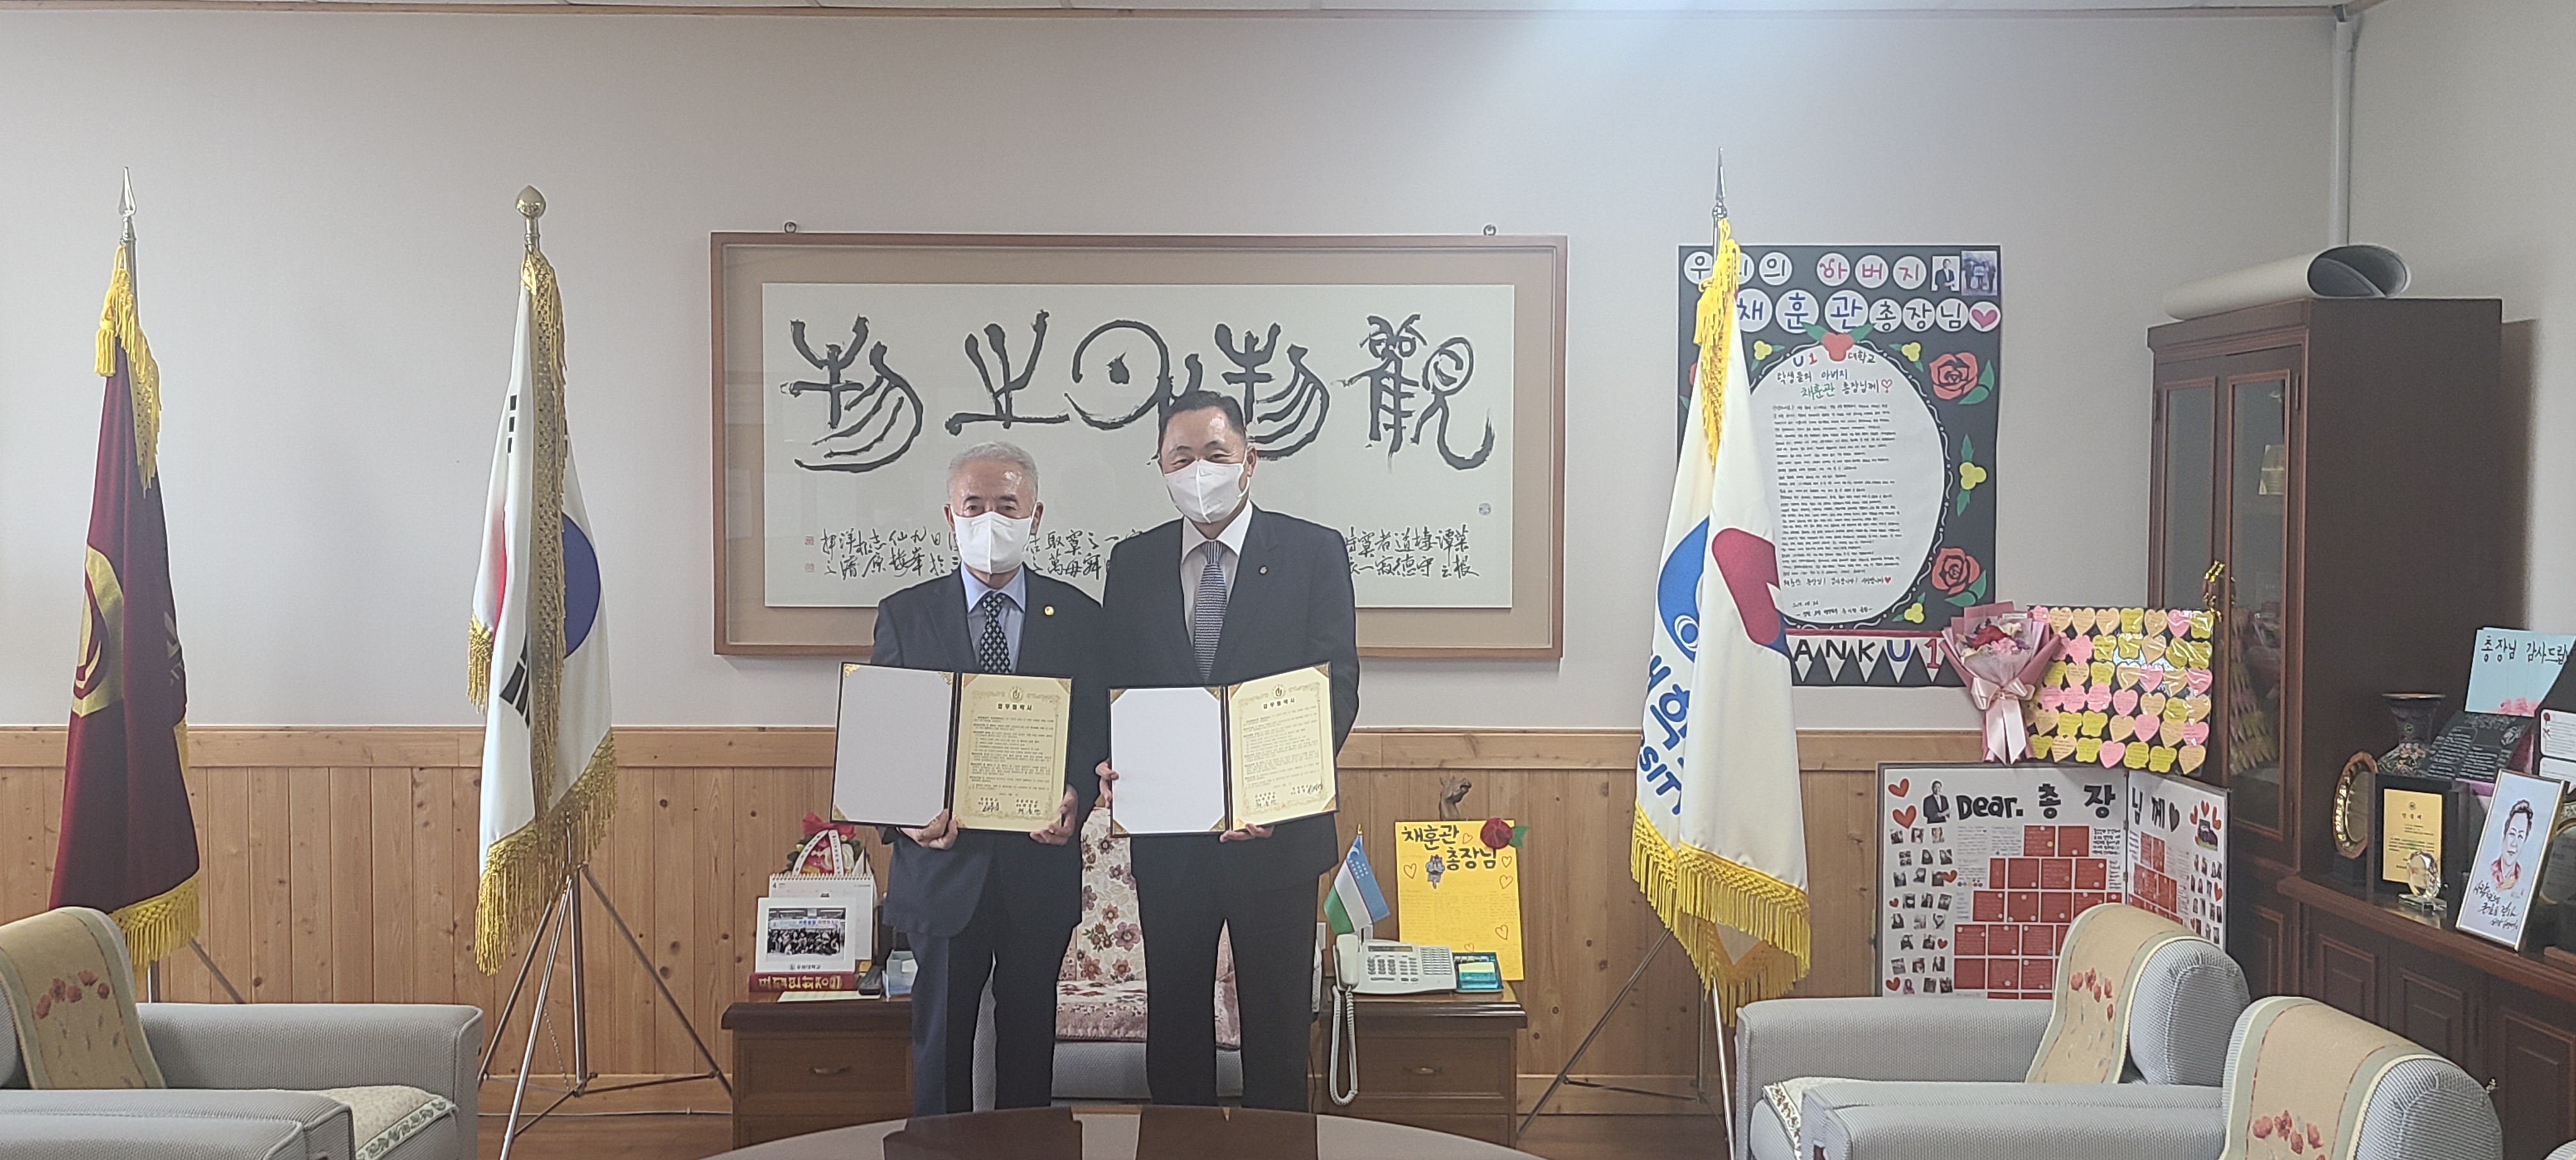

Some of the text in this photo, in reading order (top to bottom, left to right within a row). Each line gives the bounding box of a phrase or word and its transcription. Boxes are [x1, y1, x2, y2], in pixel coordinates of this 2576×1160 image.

[1690, 256, 1919, 282] 우의 아버지
[1736, 292, 1964, 332] 채훈관 총장님
[1848, 350, 1876, 363] 대학교
[1777, 369, 1848, 385] 학생들의 아버지
[1801, 383, 1835, 400] 채훈관
[2481, 636, 2517, 662] 총장님
[1956, 795, 2024, 821] Dear.
[1401, 824, 1460, 851] 채훈관
[1446, 846, 1497, 871] 총장님
